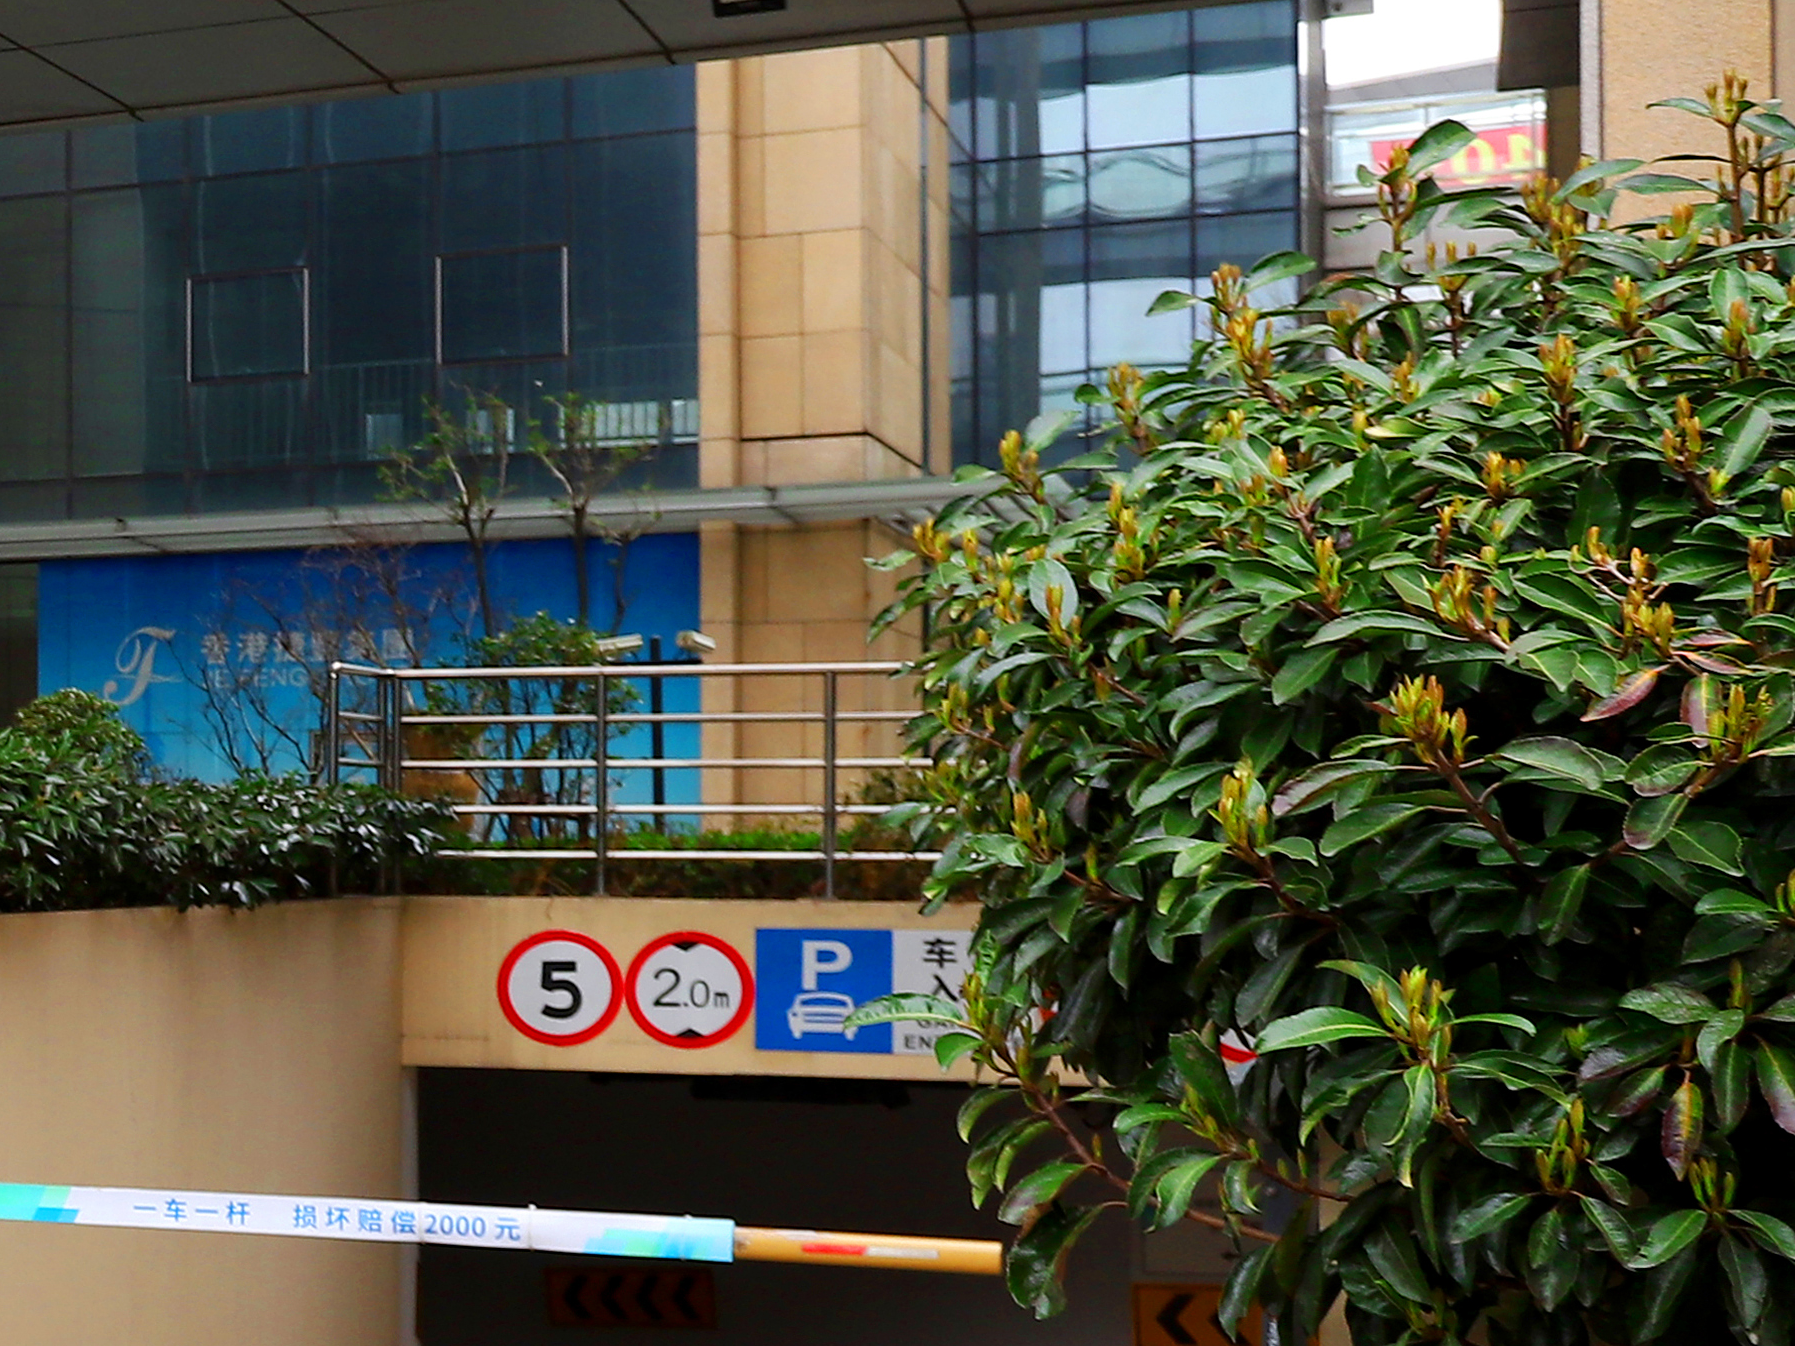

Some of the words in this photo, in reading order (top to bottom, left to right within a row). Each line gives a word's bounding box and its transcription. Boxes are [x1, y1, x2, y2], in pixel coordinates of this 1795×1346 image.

[652, 967, 731, 1009] 2.0m
[801, 939, 853, 992] P
[540, 961, 583, 1020] 5
[132, 1198, 251, 1226] 一车一杆
